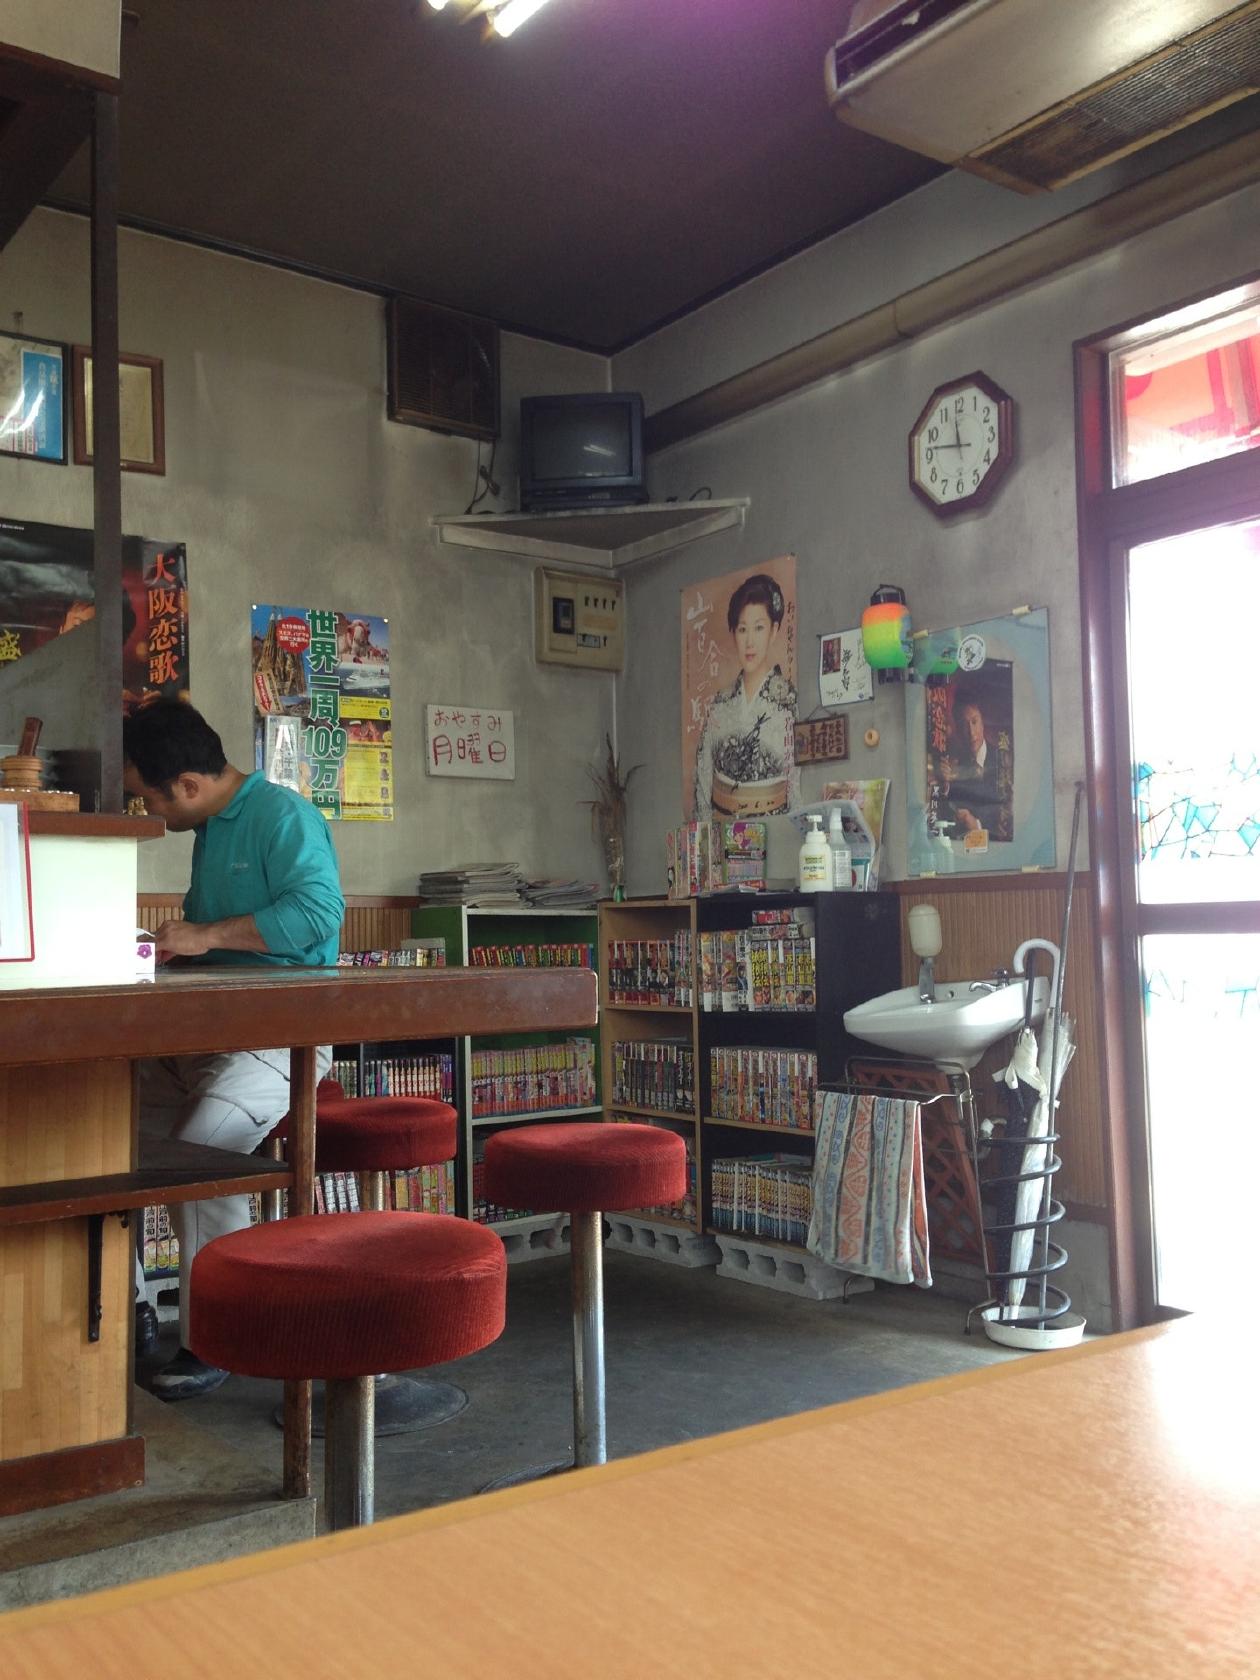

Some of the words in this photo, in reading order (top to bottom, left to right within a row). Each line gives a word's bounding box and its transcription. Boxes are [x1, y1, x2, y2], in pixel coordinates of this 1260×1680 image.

[954, 397, 964, 413] 12
[973, 396, 977, 411] 1
[940, 407, 948, 424] 11
[983, 407, 990, 423] 2
[928, 427, 938, 444] 10
[988, 426, 995, 443] 3
[926, 447, 933, 464] 9
[983, 448, 990, 465] 4
[930, 467, 937, 483] 8
[973, 469, 980, 485] 5
[941, 479, 948, 495] 7
[956, 479, 963, 494] 6
[148, 553, 179, 684] 大阪恋歌
[305, 609, 347, 820] 世界一周109万円
[434, 710, 502, 732] おやすみ
[432, 732, 507, 766] 月曜日
